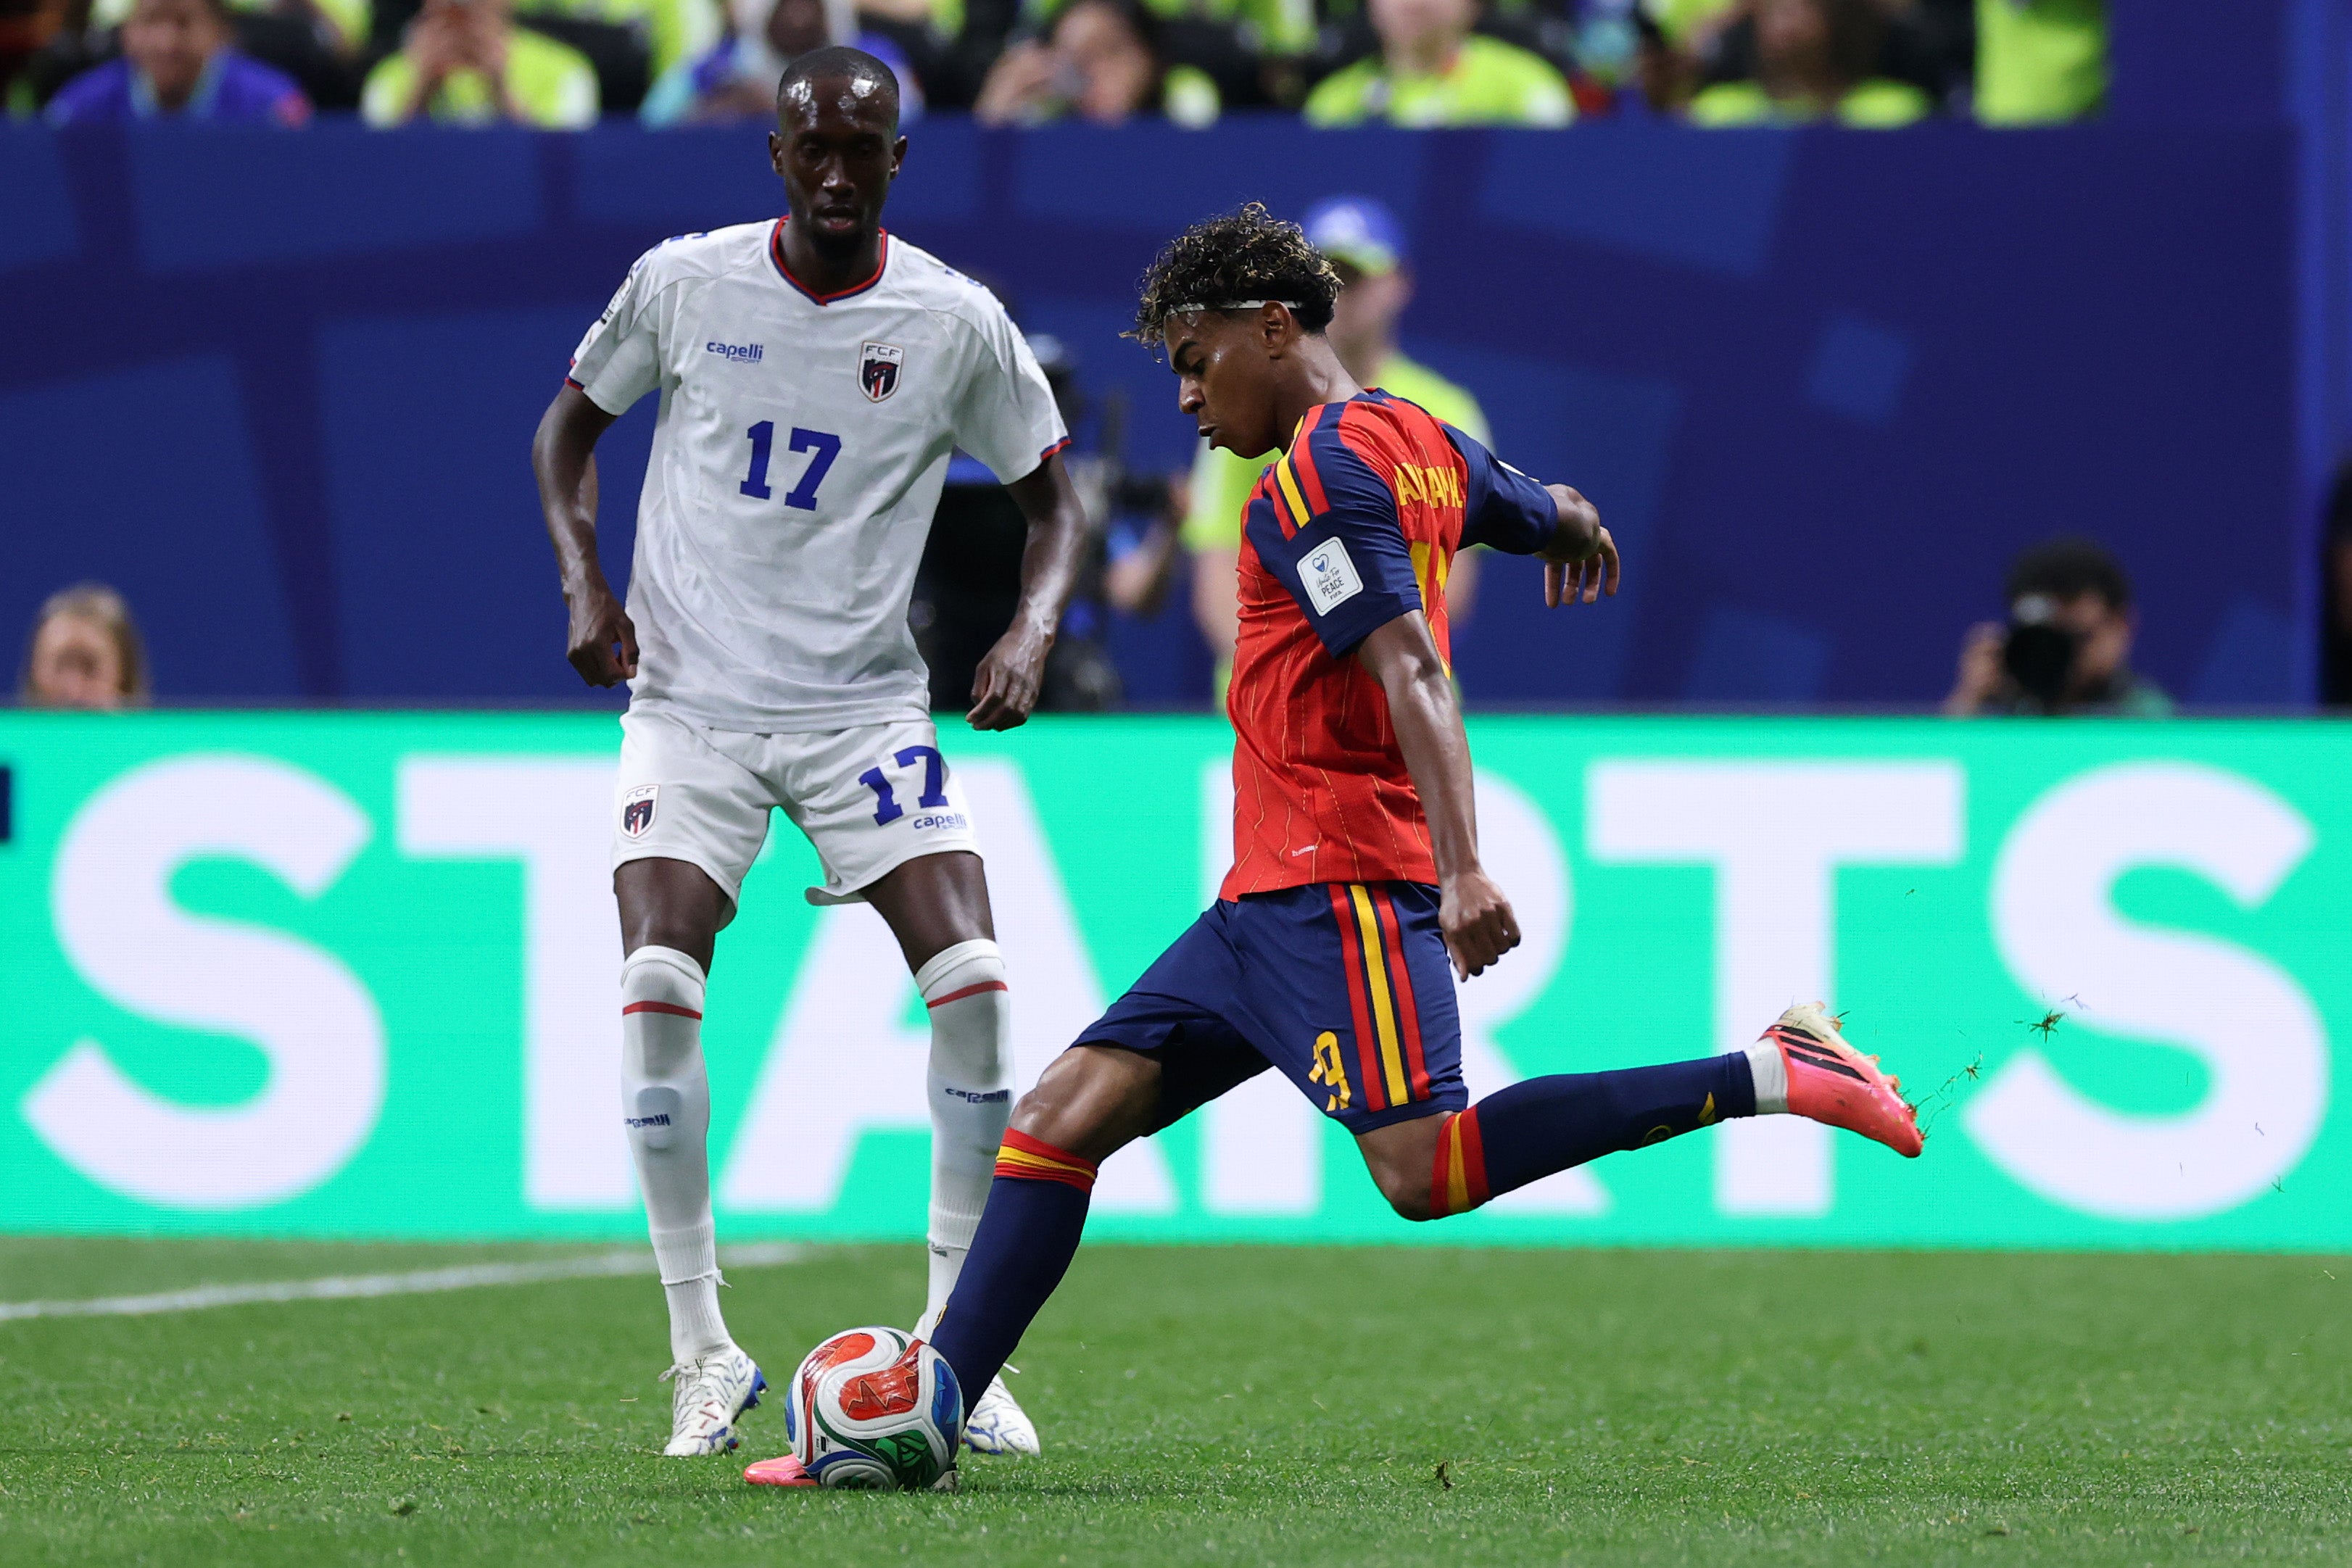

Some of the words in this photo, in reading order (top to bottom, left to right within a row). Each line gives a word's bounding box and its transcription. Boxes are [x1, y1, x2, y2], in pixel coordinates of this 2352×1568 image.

[706, 342, 763, 359] capelli
[866, 345, 900, 357] FCF
[740, 420, 842, 511] 17
[1321, 576, 1345, 597] PEACE
[626, 787, 655, 800] FCF
[858, 745, 949, 826] 17
[914, 813, 967, 829] capelli
[22, 752, 2328, 1219] STARTS
